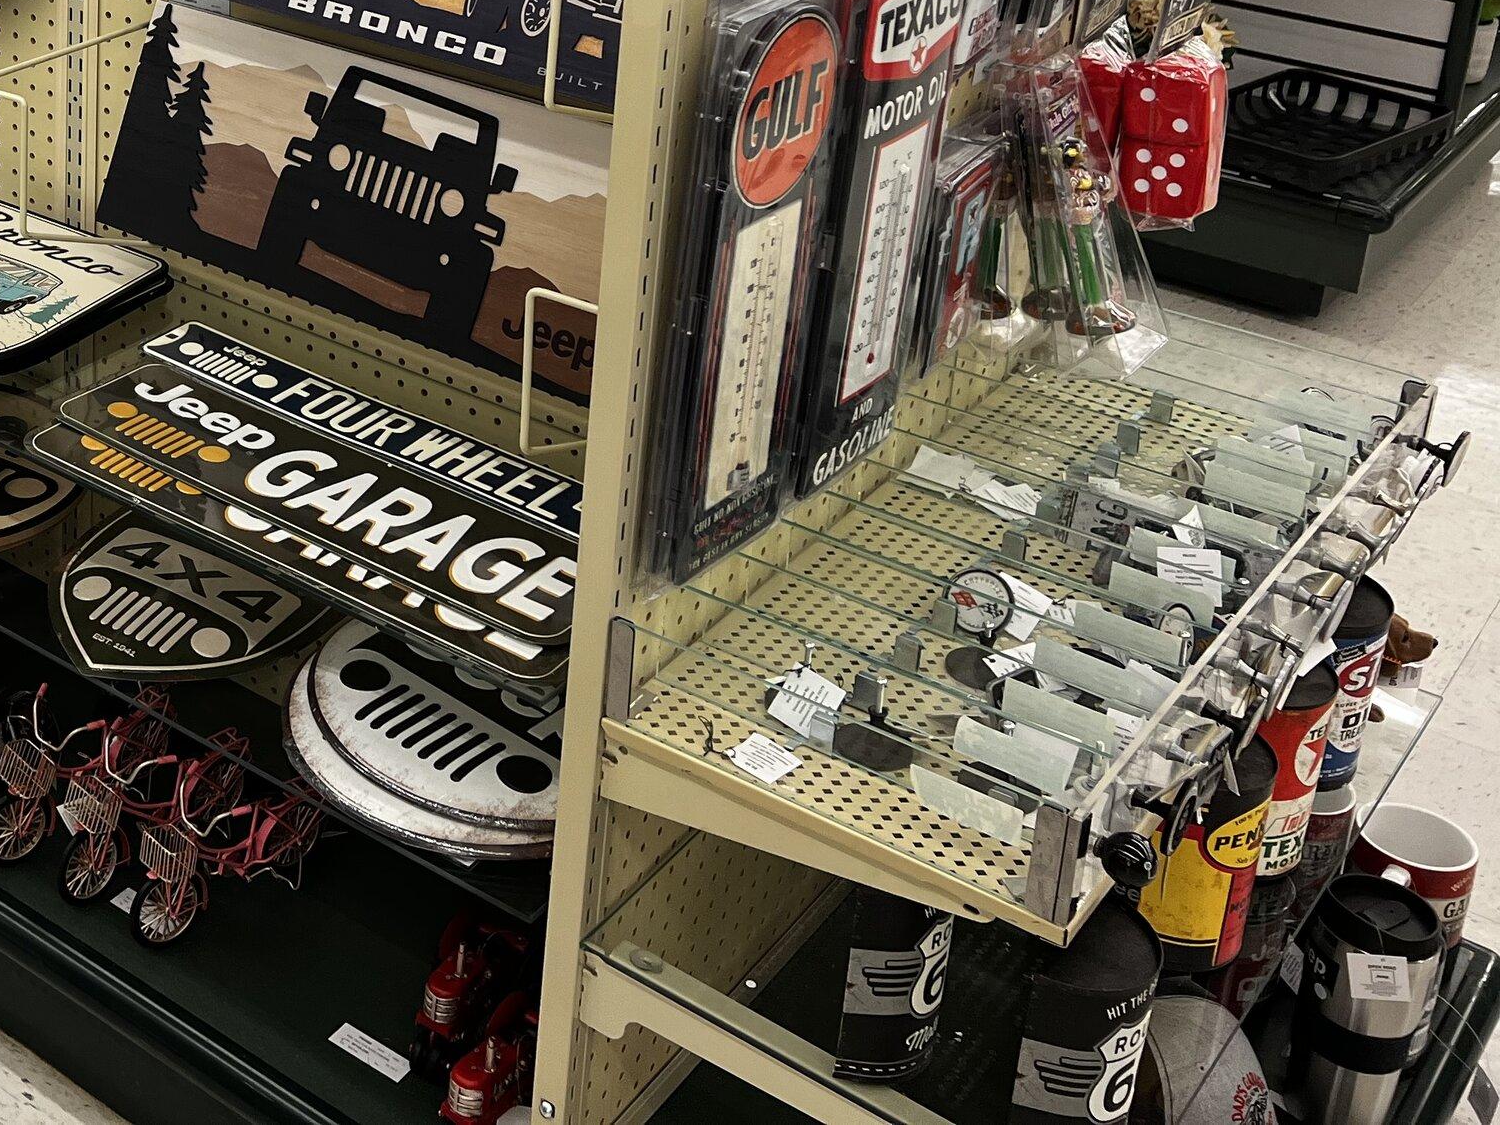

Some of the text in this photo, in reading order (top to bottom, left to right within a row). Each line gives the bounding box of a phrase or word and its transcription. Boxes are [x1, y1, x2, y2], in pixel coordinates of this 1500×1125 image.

[742, 58, 830, 163] GULF
[864, 87, 923, 139] MOTOR
[222, 343, 269, 367] Jeep
[134, 382, 276, 450] Jeep
[812, 404, 895, 487] GASOLINE
[851, 397, 873, 425] AND
[271, 377, 572, 521] FOUR WHEEL
[245, 449, 580, 623] GARAGE
[106, 540, 287, 625] 4X4
[1106, 1002, 1128, 1020] HIT
